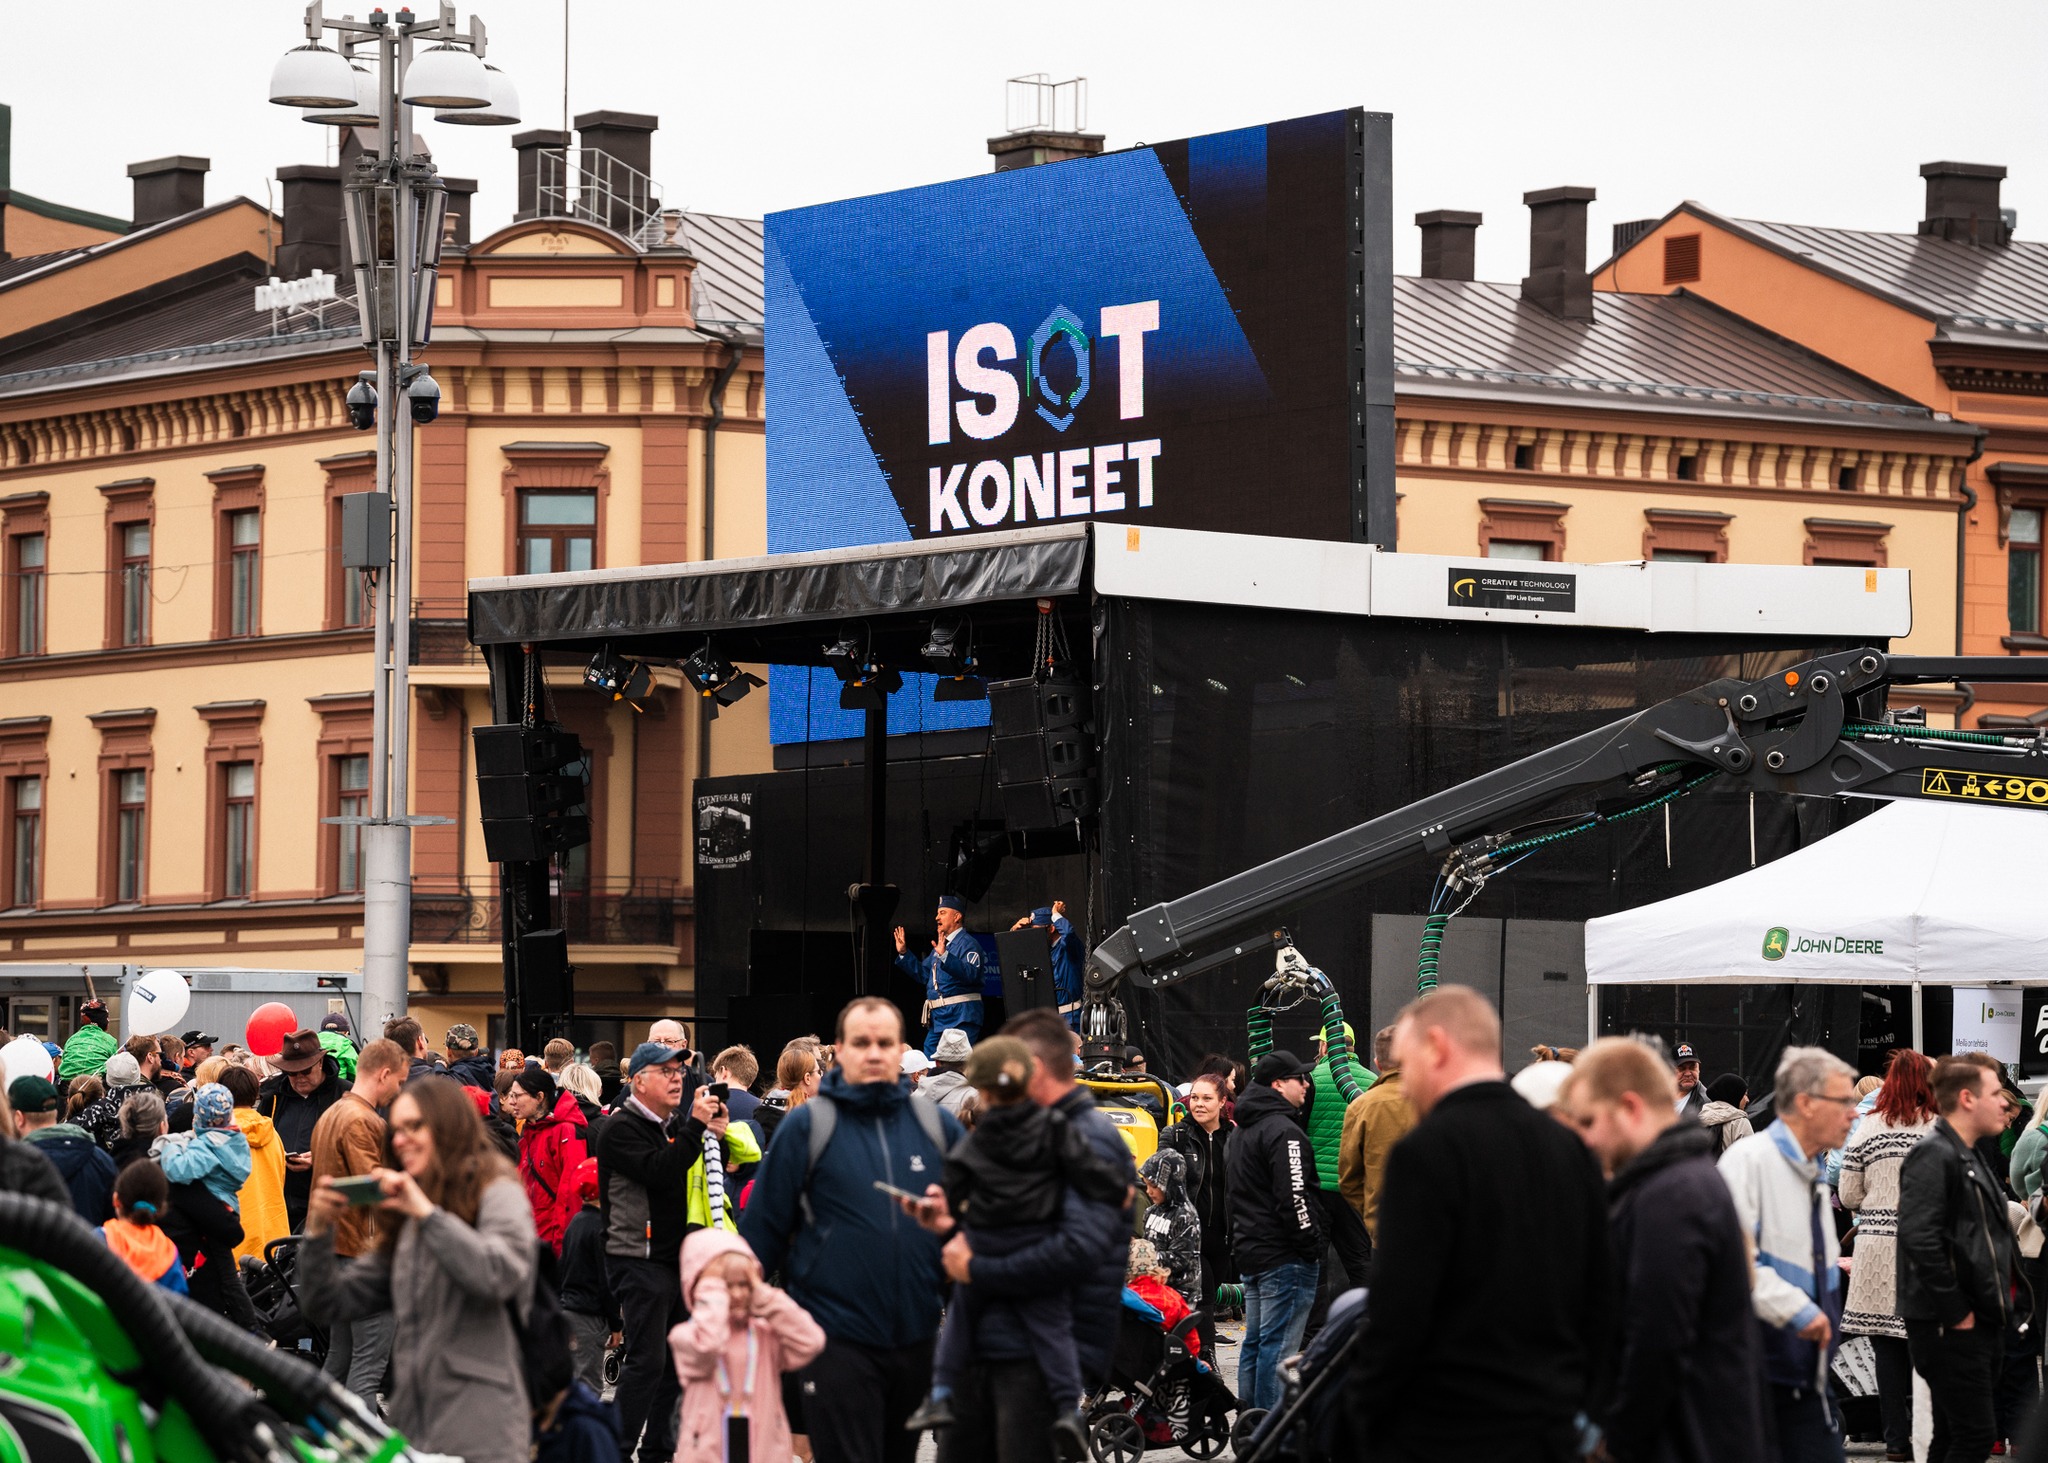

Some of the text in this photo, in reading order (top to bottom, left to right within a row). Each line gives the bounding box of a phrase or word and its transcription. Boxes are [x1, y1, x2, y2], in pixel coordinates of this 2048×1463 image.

[927, 299, 1160, 446] ISOT
[928, 438, 1162, 533] KONEET
[1481, 578, 1571, 590] CREATIVE TECHNOLOGY
[1516, 594, 1528, 602] Live
[741, 792, 753, 806] OY
[1791, 936, 1884, 955] JOHN DEERE
[1287, 1140, 1312, 1230] HELLY HANSEN
